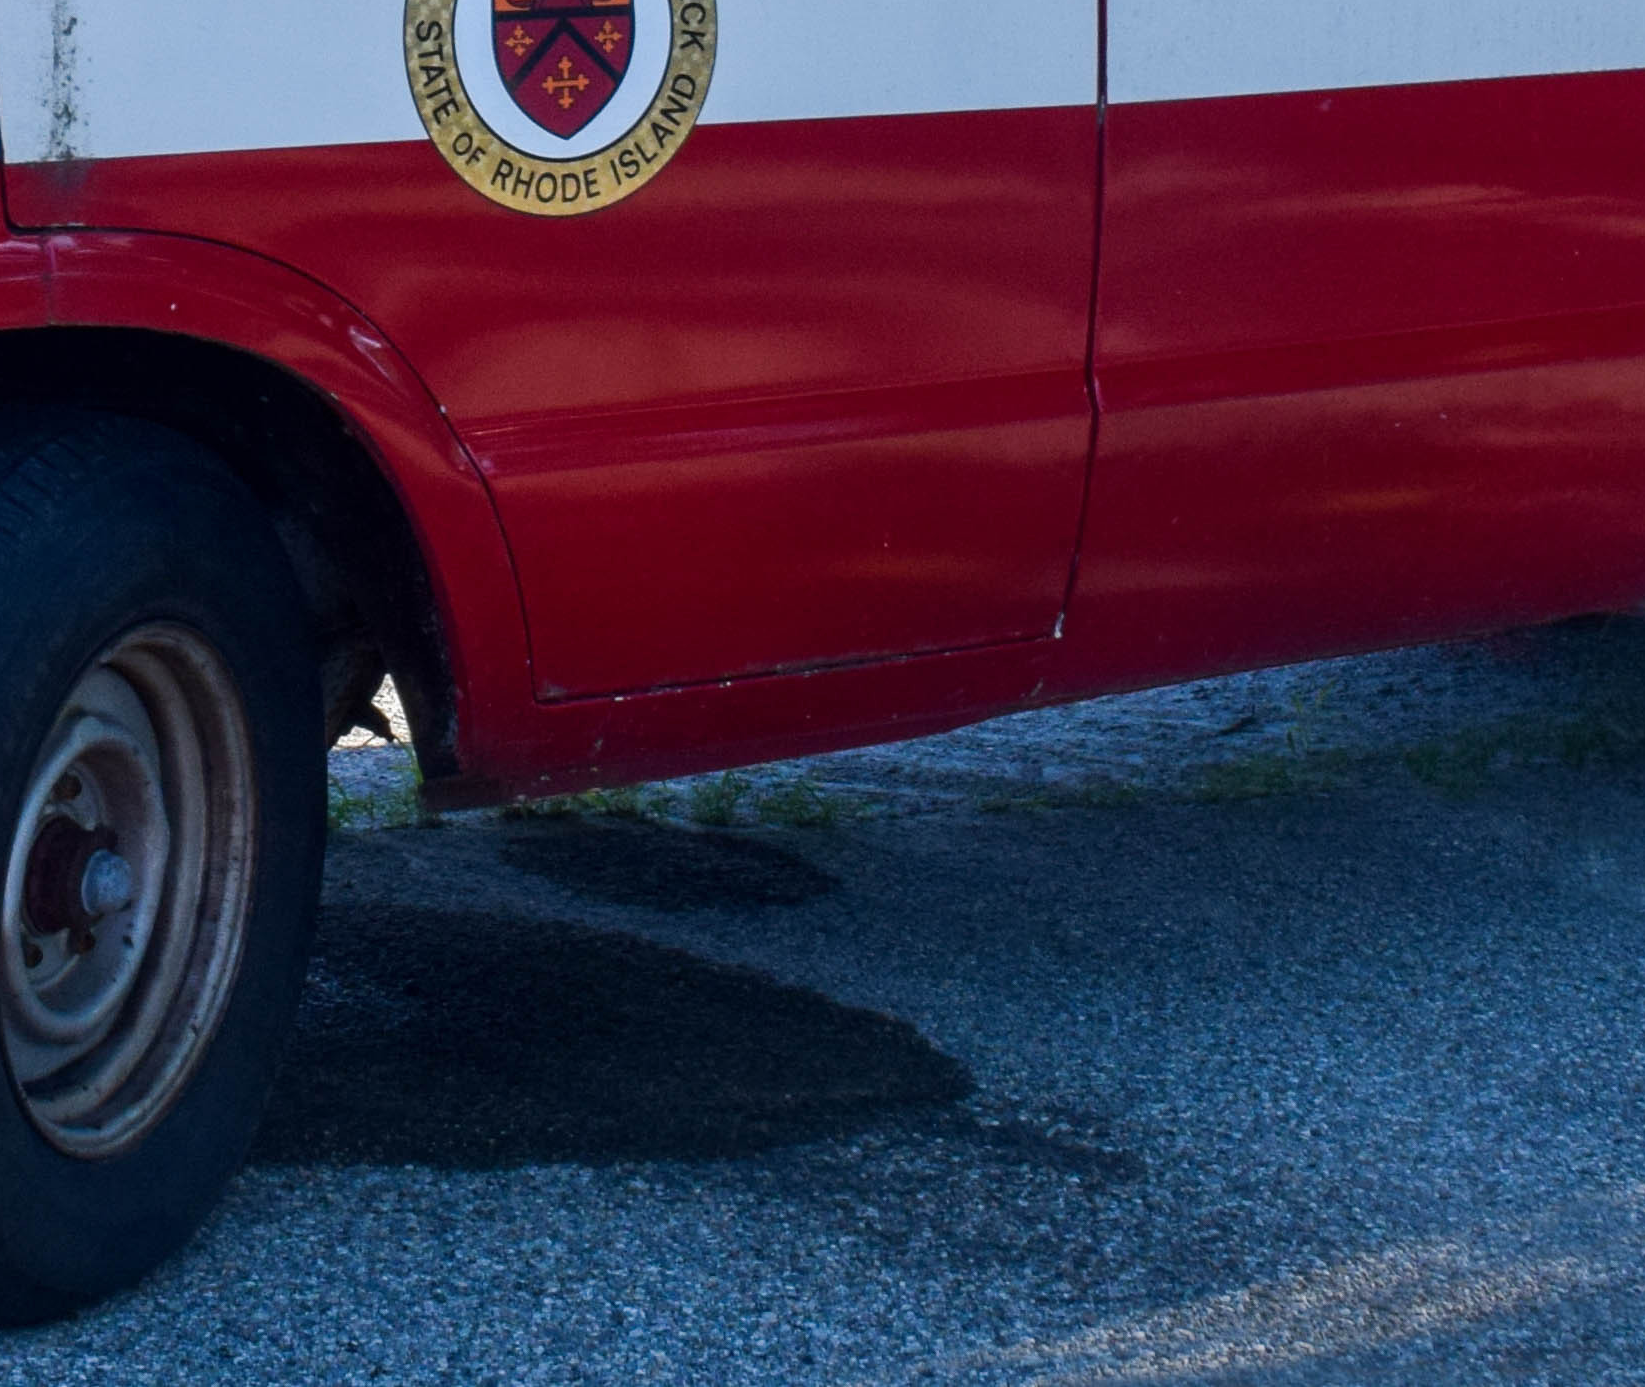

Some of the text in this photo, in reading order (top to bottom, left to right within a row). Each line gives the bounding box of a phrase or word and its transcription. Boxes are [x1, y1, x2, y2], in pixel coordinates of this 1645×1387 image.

[415, 19, 697, 204] STATE OF RHODE ISLAND
